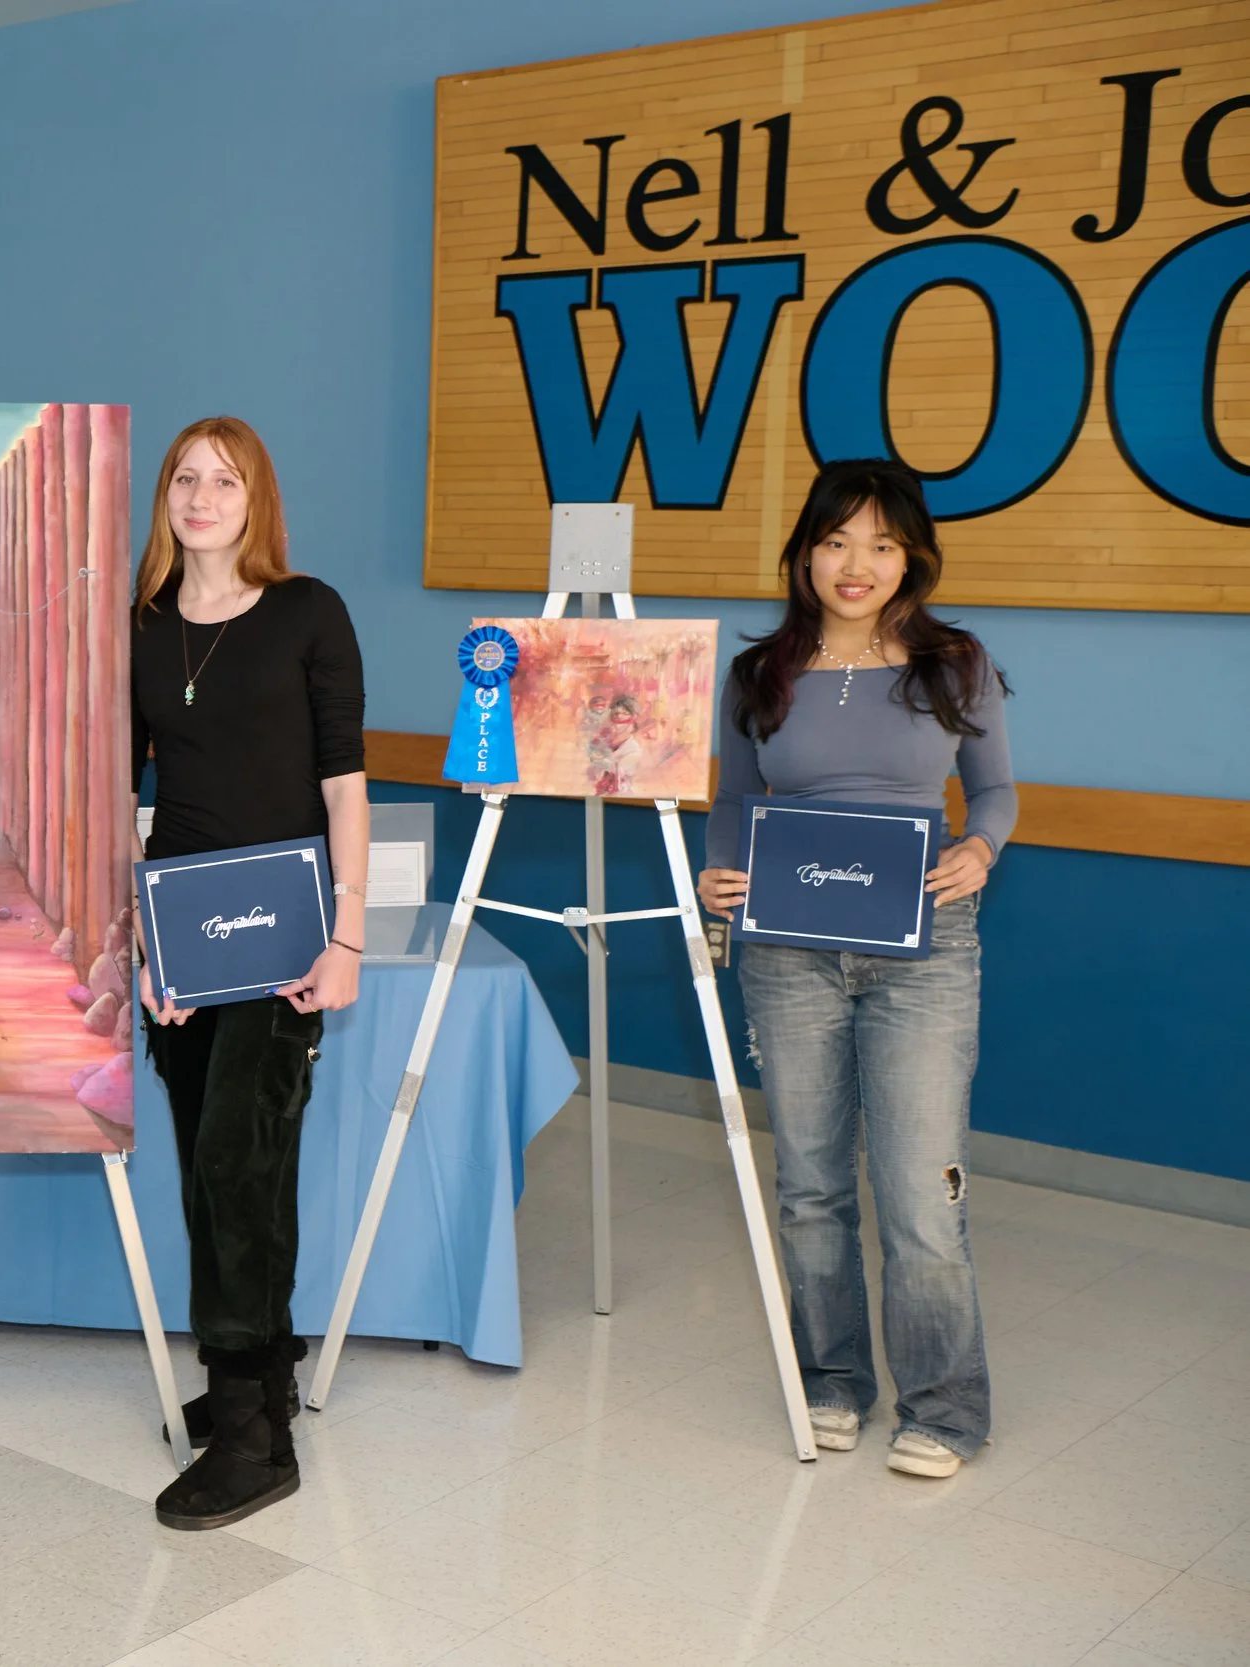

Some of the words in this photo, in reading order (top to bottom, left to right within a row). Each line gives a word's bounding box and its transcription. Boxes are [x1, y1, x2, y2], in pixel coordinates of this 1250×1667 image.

[502, 113, 800, 260] Nell
[865, 95, 1020, 235] &
[477, 712, 491, 772] PLACE
[796, 862, 874, 887] Congratulations
[201, 906, 276, 940] Congratulations
